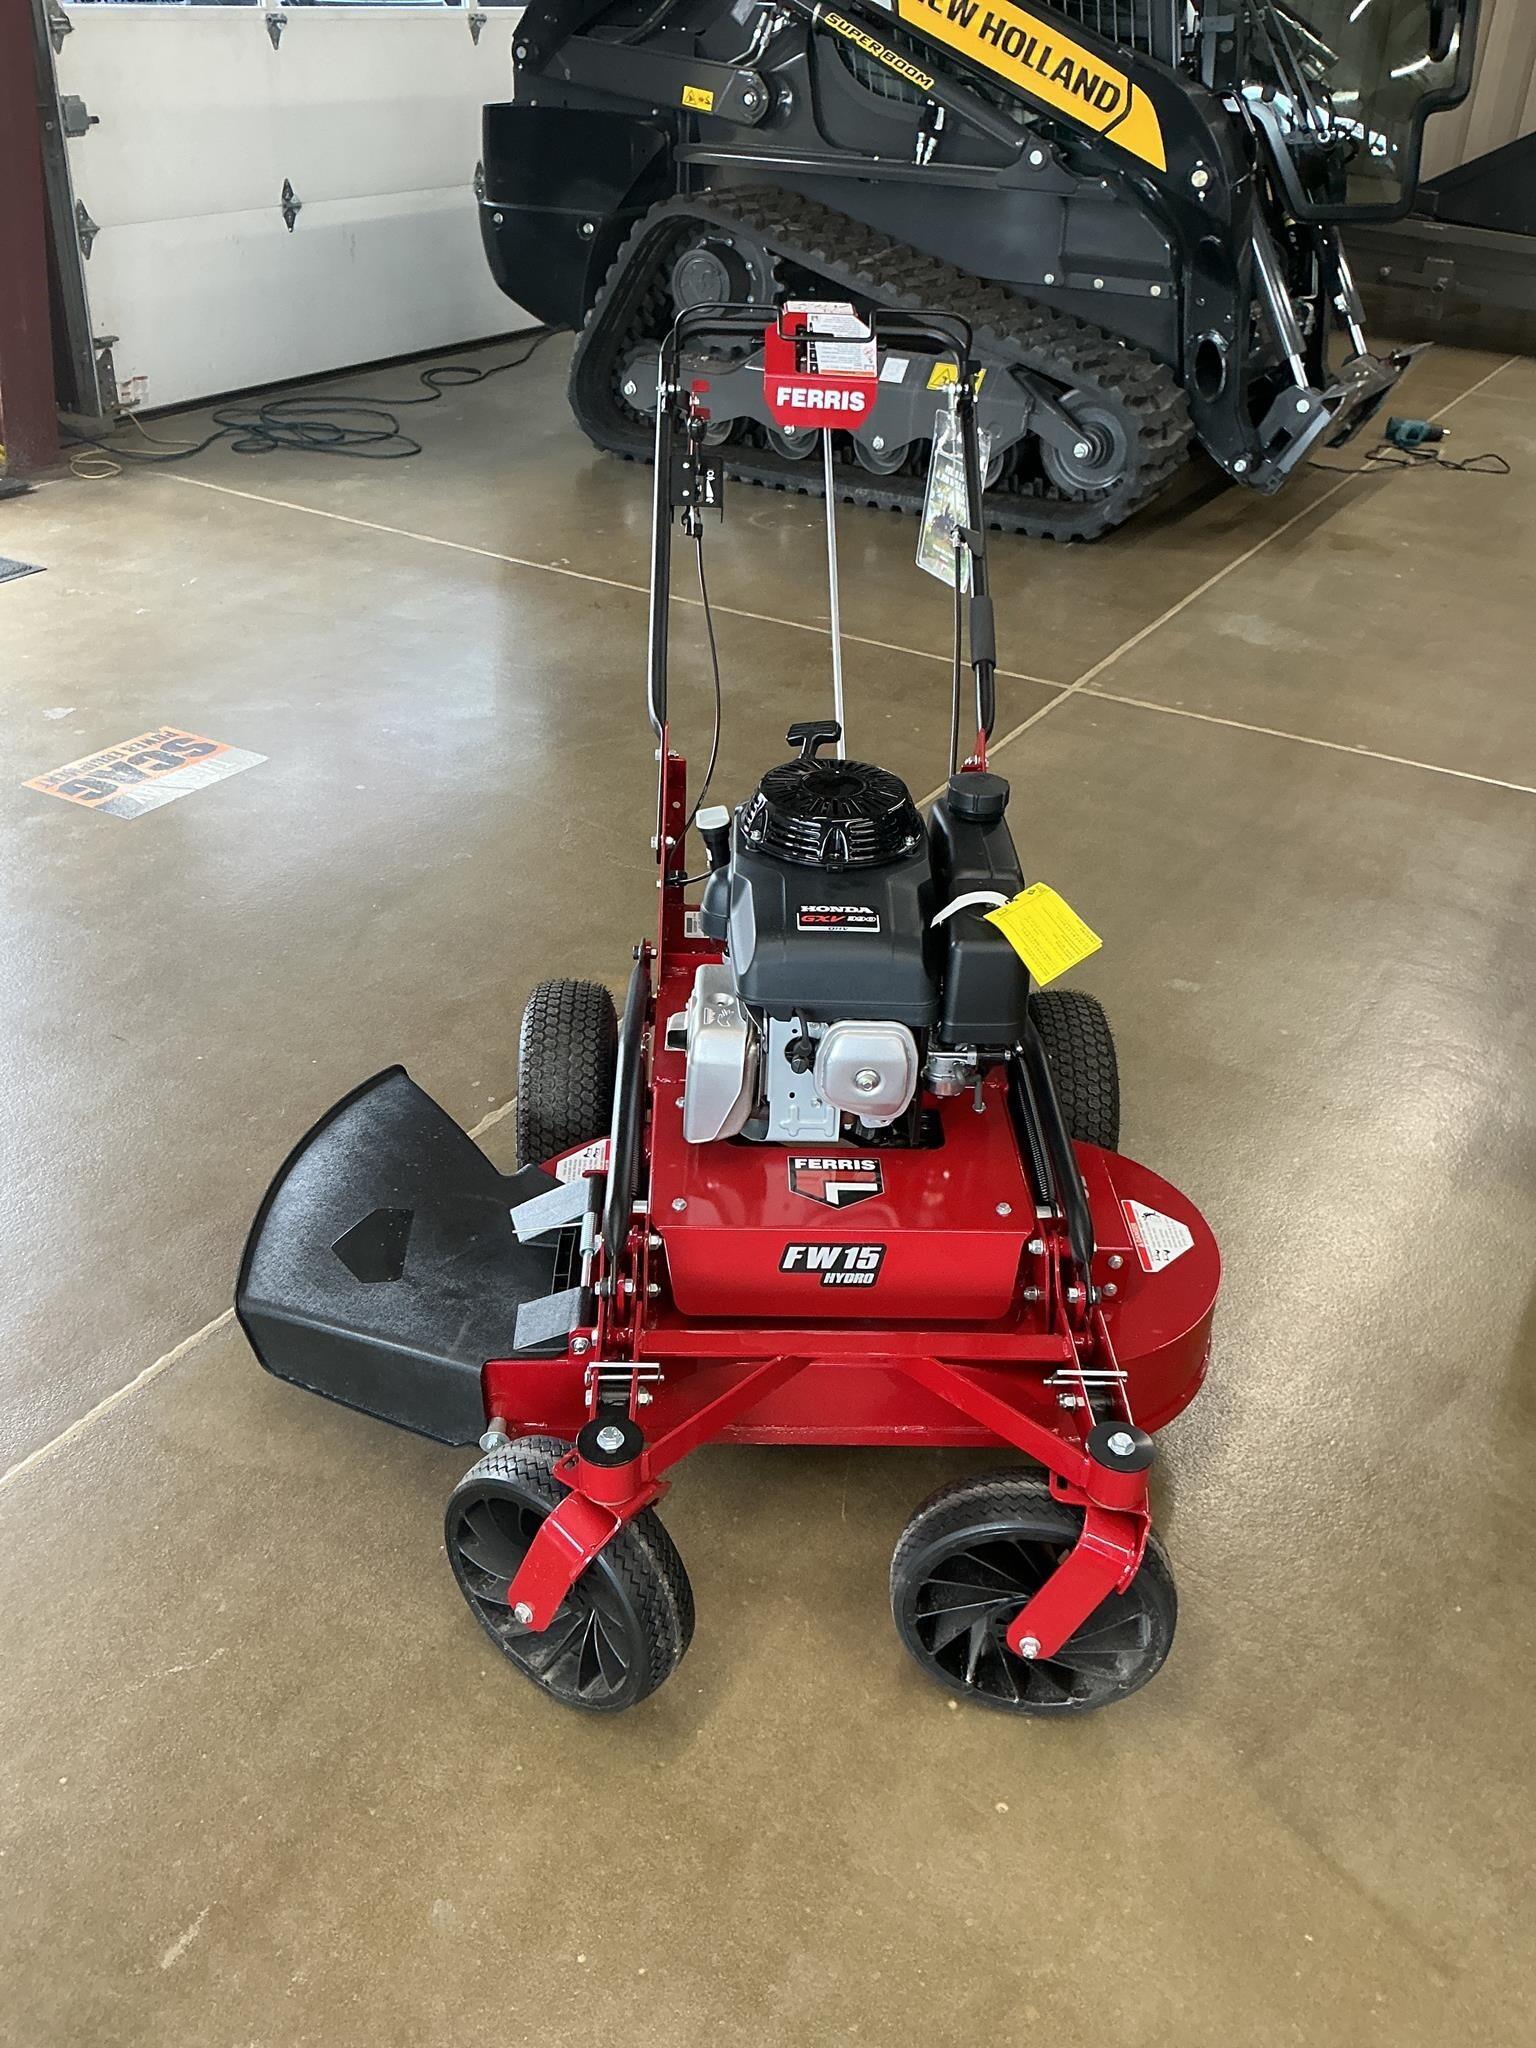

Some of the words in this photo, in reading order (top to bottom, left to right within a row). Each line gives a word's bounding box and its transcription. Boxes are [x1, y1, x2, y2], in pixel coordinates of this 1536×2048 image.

[826, 13, 882, 54] SUPER
[882, 50, 934, 88] BOOM
[978, 12, 1121, 114] HOLLAND
[776, 387, 865, 412] FERRIS
[58, 737, 218, 801] SCAG
[801, 905, 874, 914] HONDA
[794, 1158, 876, 1170] FERRIS
[823, 1272, 875, 1284] HYDRO
